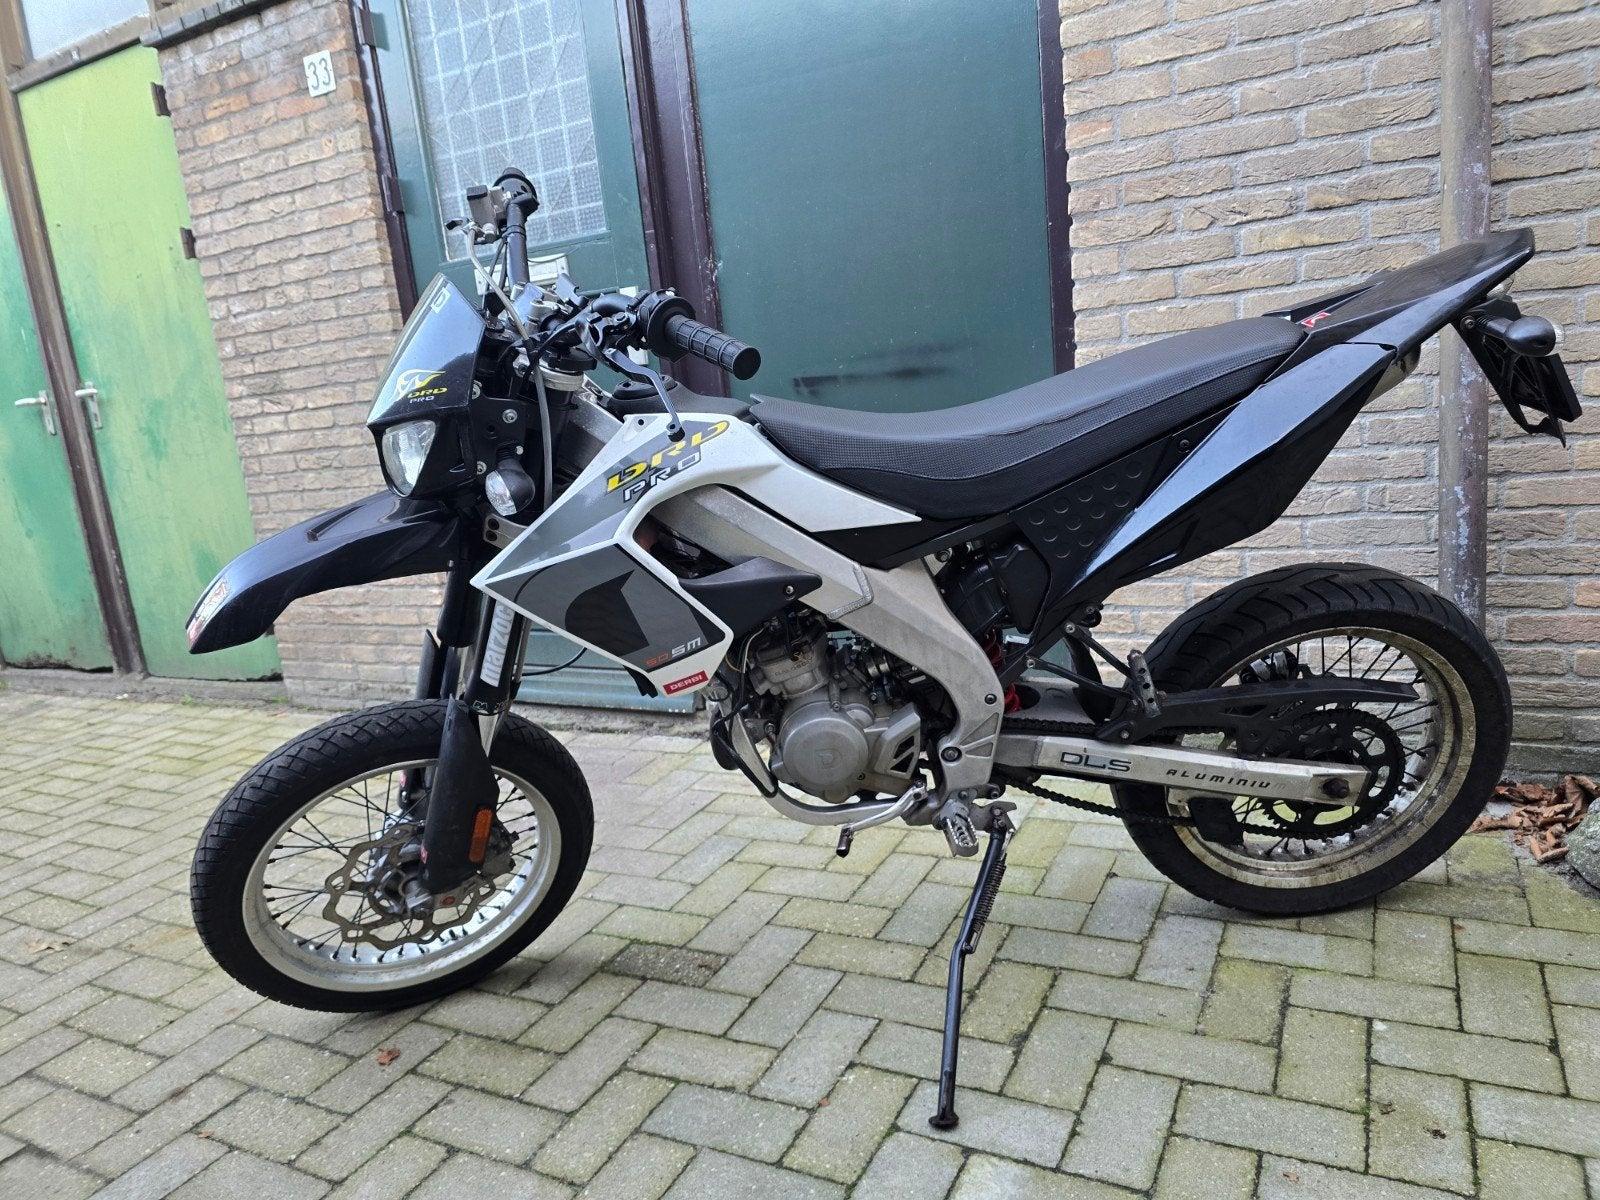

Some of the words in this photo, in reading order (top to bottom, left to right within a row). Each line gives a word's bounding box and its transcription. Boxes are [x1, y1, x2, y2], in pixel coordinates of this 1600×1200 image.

[307, 57, 331, 91] 33
[407, 387, 448, 399] DRD
[409, 395, 435, 404] PRO
[606, 420, 730, 493] DRD
[623, 451, 701, 502] PRO
[669, 674, 704, 690] DERBI
[1060, 751, 1133, 772] DLS
